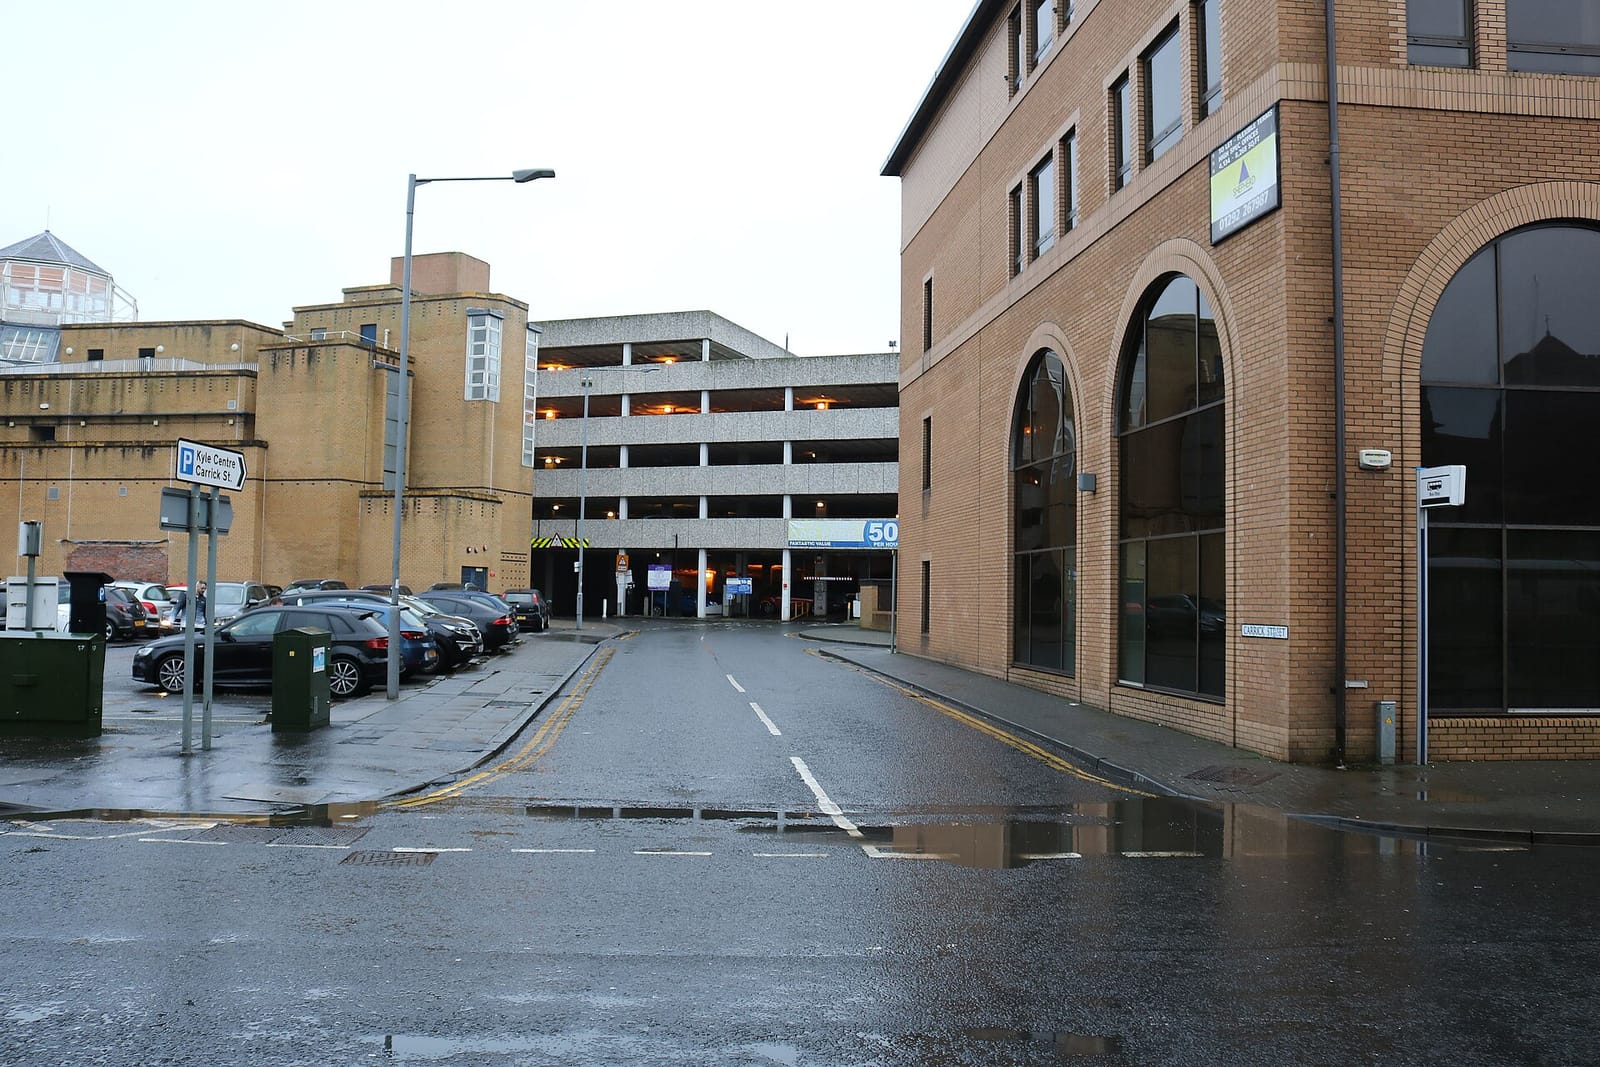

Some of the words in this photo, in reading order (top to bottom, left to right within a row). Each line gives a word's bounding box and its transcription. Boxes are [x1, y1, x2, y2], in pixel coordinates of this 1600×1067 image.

[183, 450, 193, 472] P
[196, 449, 212, 463] Kyle
[213, 454, 236, 469] Centre
[195, 464, 221, 480] Carrick
[222, 470, 233, 483] St.
[1243, 625, 1265, 635] CARRICK
